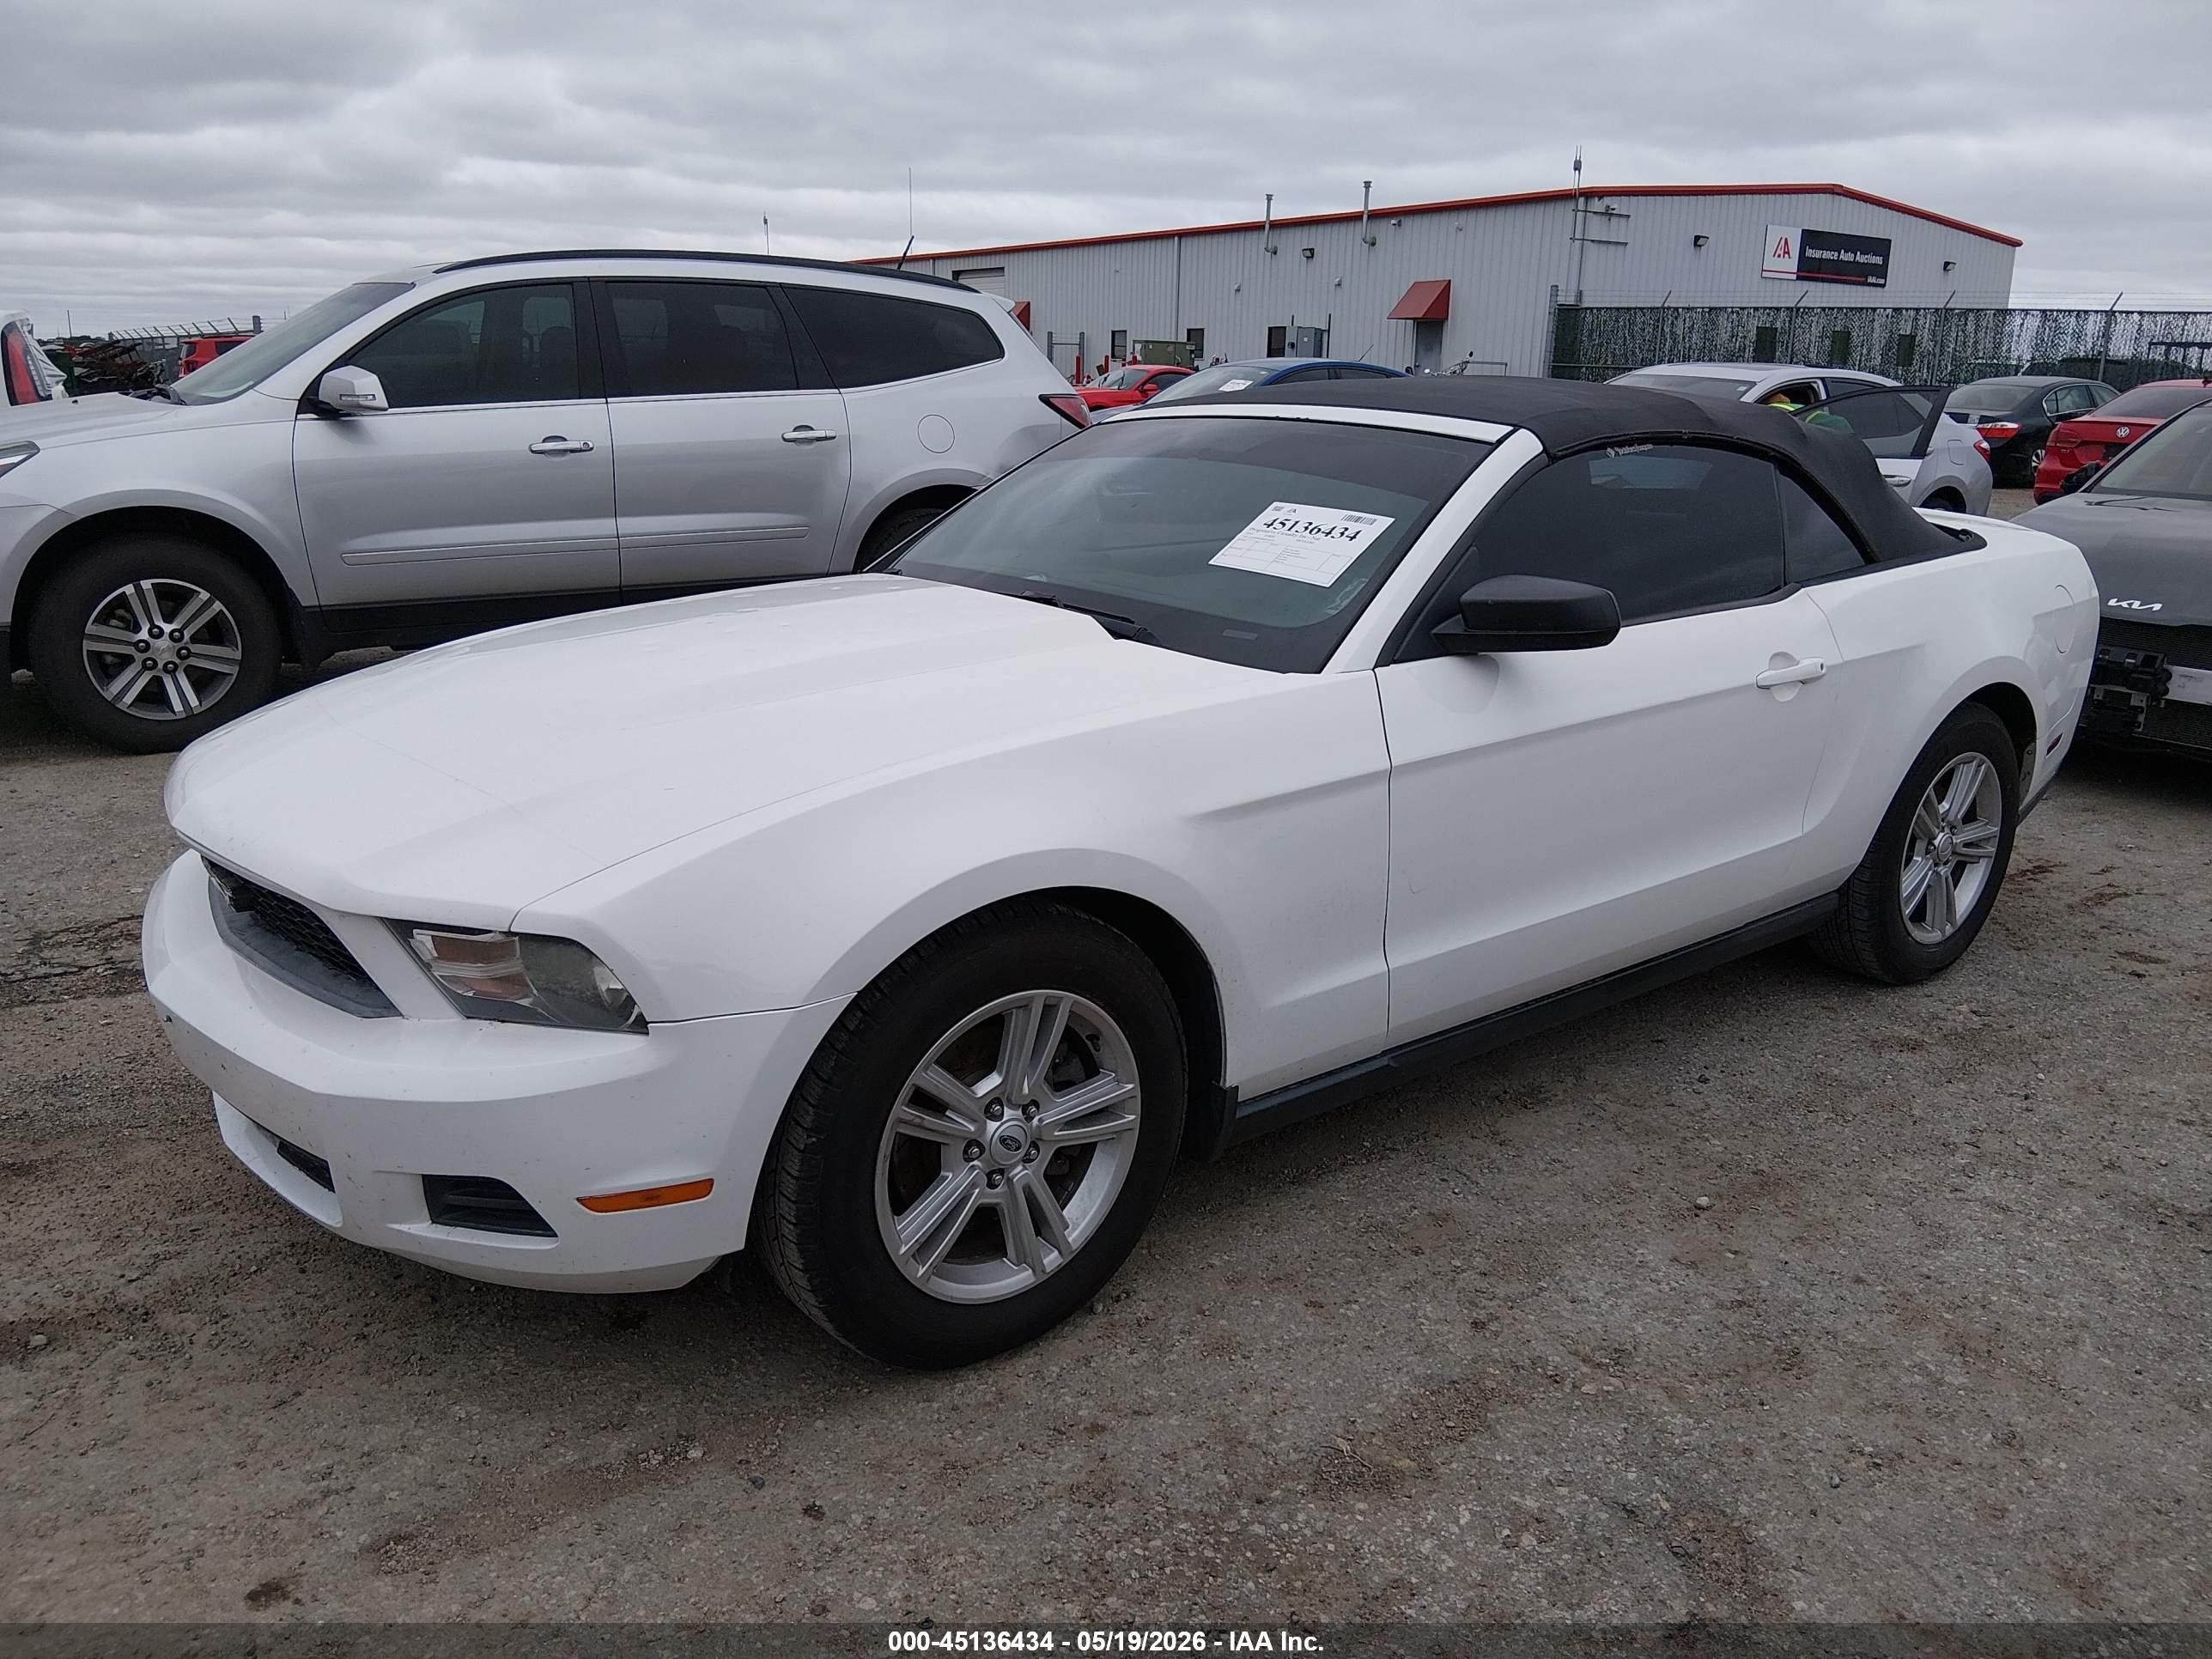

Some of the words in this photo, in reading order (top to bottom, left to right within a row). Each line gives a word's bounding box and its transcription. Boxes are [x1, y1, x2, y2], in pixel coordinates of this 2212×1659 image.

[1805, 245, 1838, 260] Insurance
[1838, 248, 1855, 262] Auto
[1855, 251, 1884, 265] Auctions
[1262, 517, 1364, 542] 45136434
